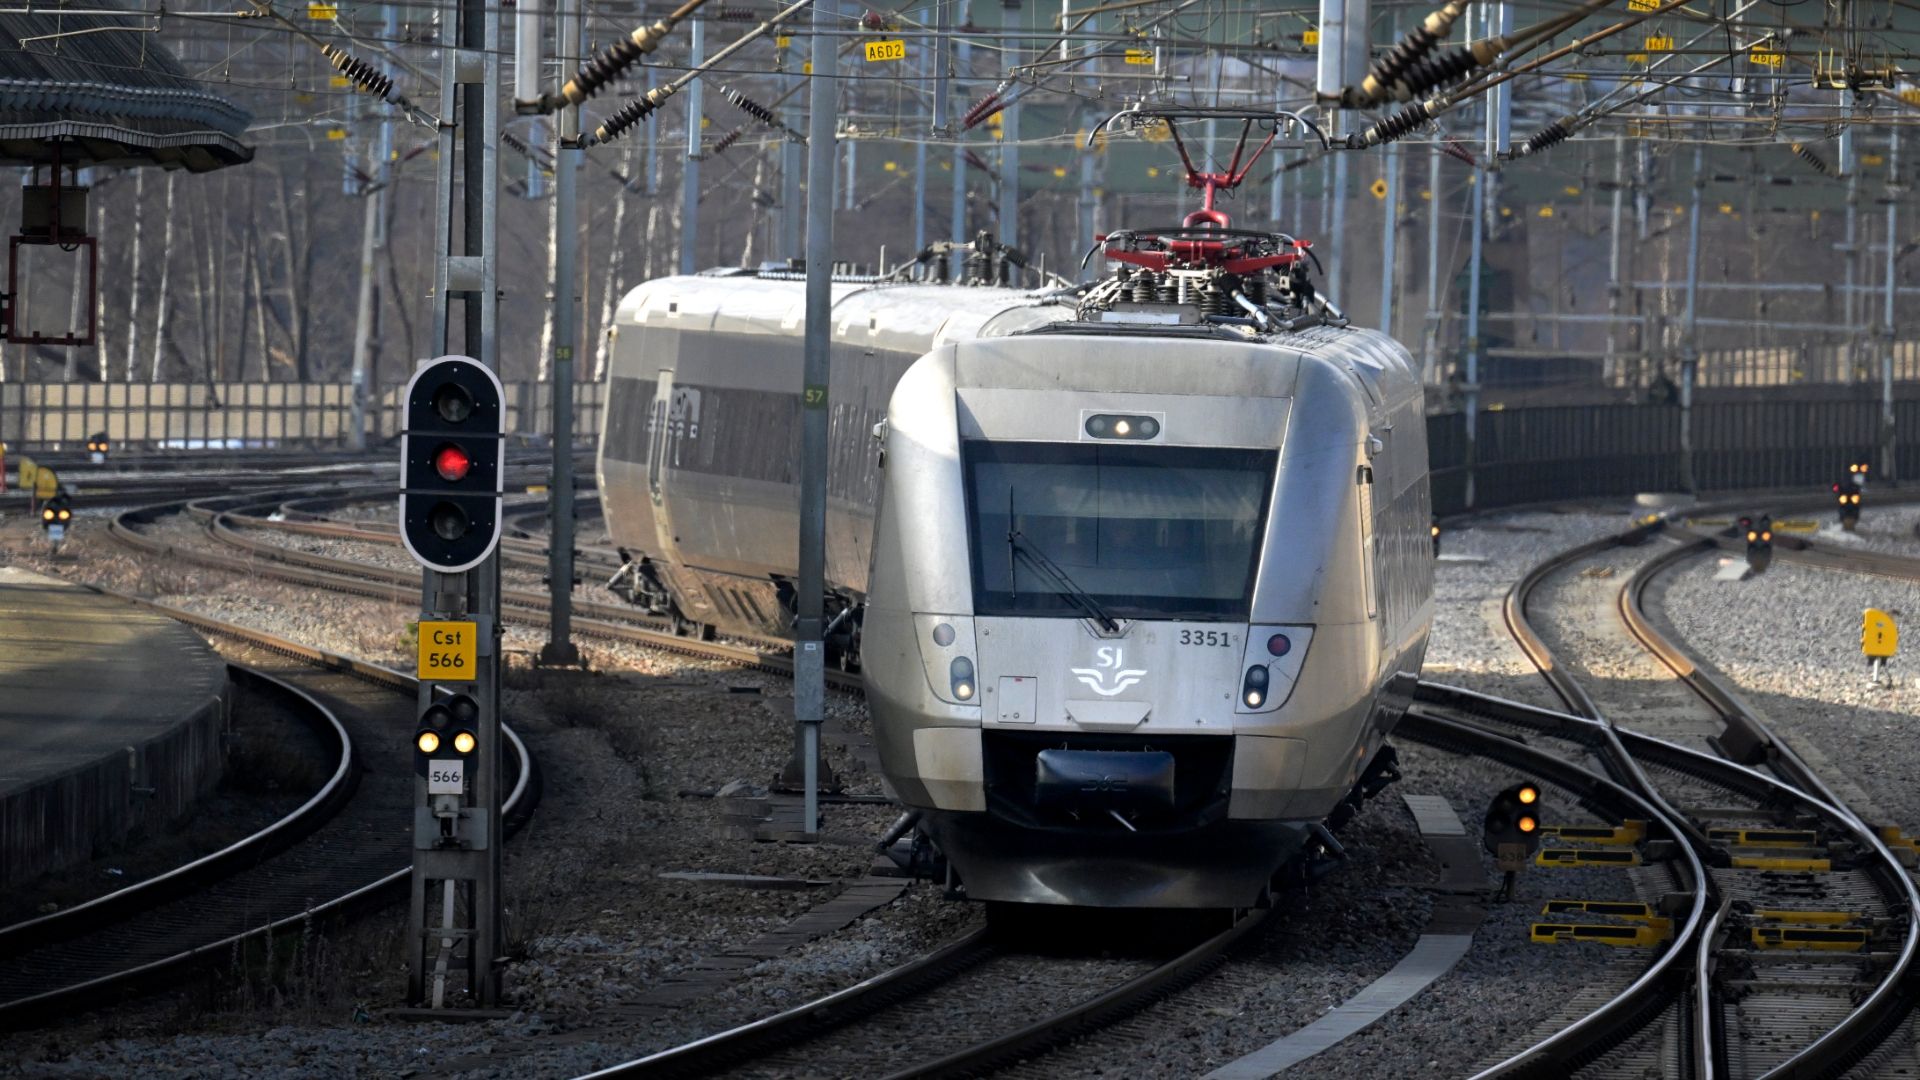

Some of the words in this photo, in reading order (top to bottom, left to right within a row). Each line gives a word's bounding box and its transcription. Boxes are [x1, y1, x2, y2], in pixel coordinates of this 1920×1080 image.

[869, 44, 902, 60] A6D2
[806, 389, 823, 403] 57
[433, 630, 461, 645] Cst
[1180, 629, 1231, 648] 3351
[429, 653, 464, 667] 566
[1096, 646, 1123, 669] SJ
[433, 771, 460, 783] 566
